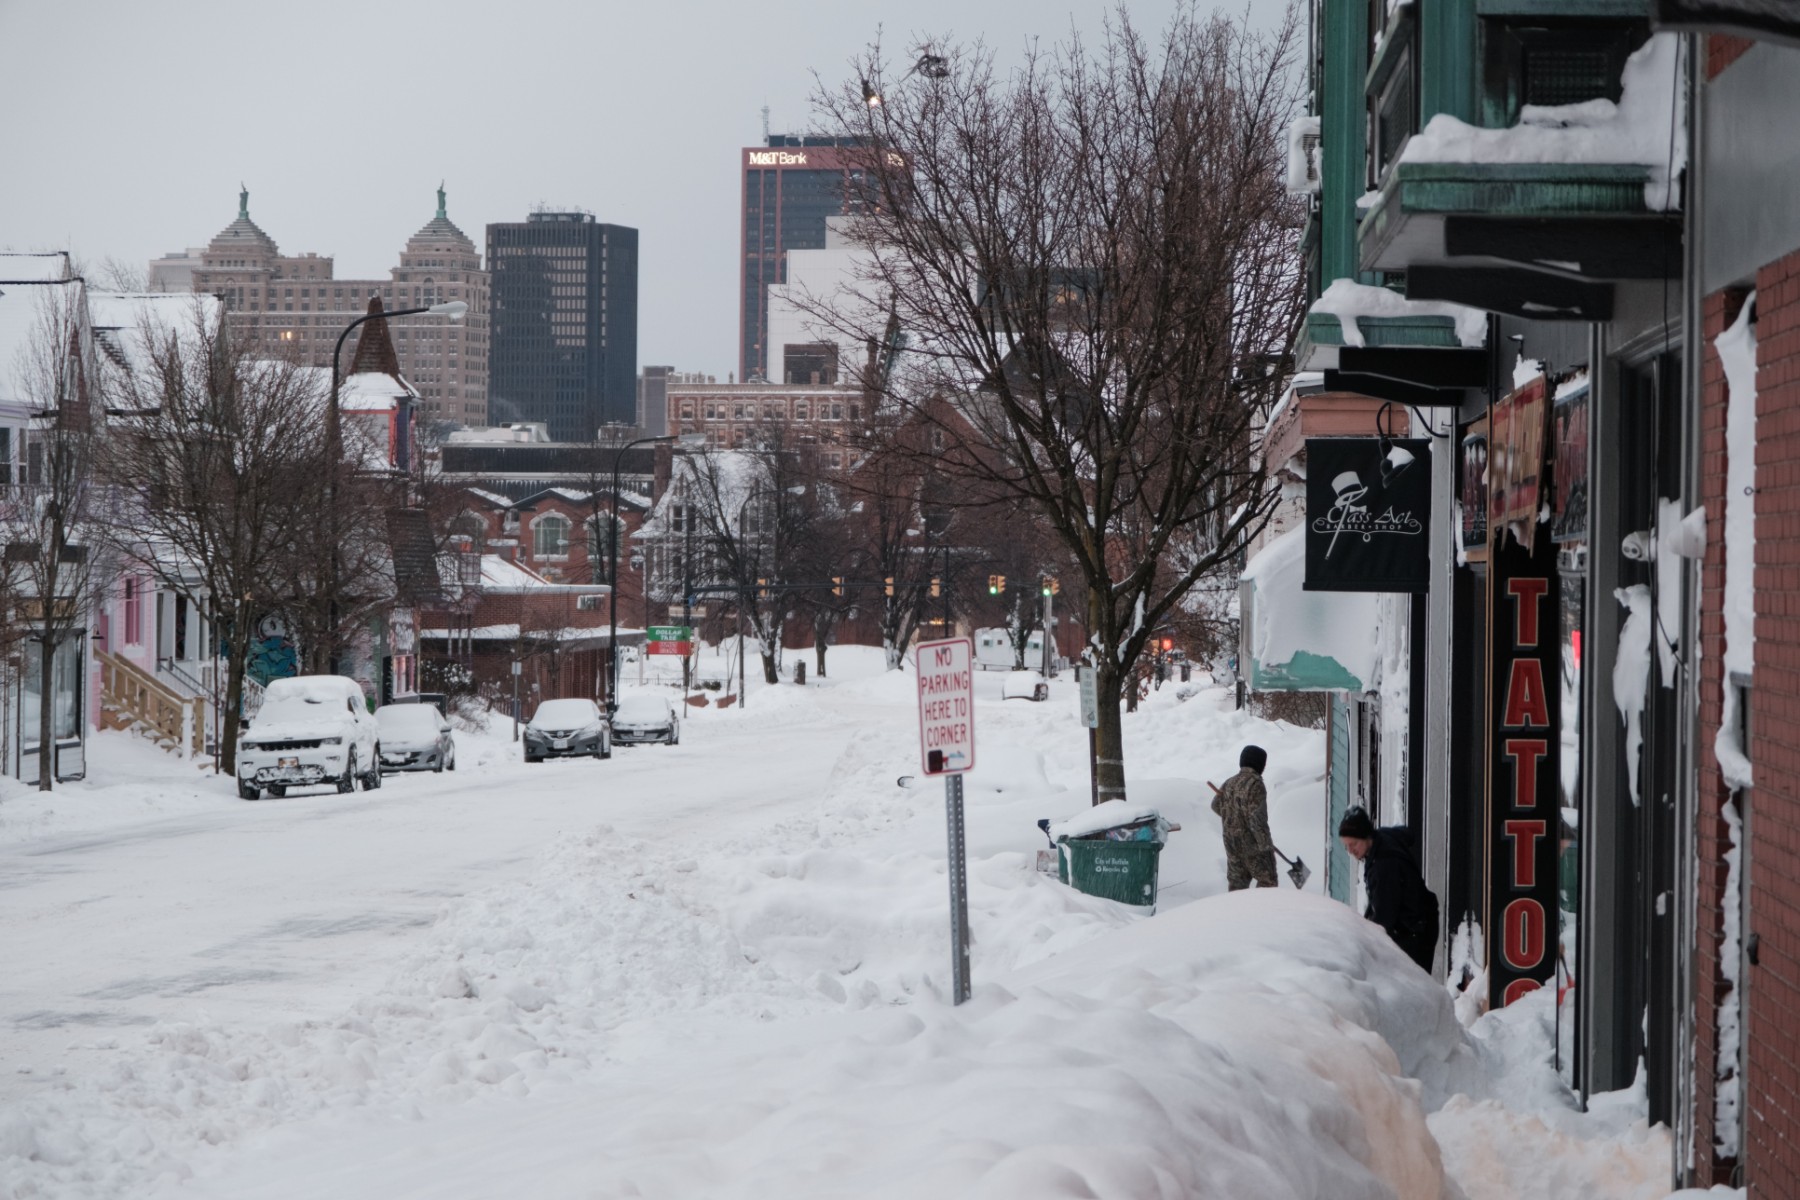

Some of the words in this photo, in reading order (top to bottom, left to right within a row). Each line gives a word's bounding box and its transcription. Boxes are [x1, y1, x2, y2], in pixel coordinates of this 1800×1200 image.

[749, 152, 778, 164] M&T
[779, 152, 807, 164] Bank
[1374, 505, 1411, 524] Act
[935, 646, 953, 668] NO
[920, 670, 969, 696] PARKING
[925, 699, 952, 721] HERE
[953, 697, 967, 718] TO
[926, 723, 967, 748] CORNER
